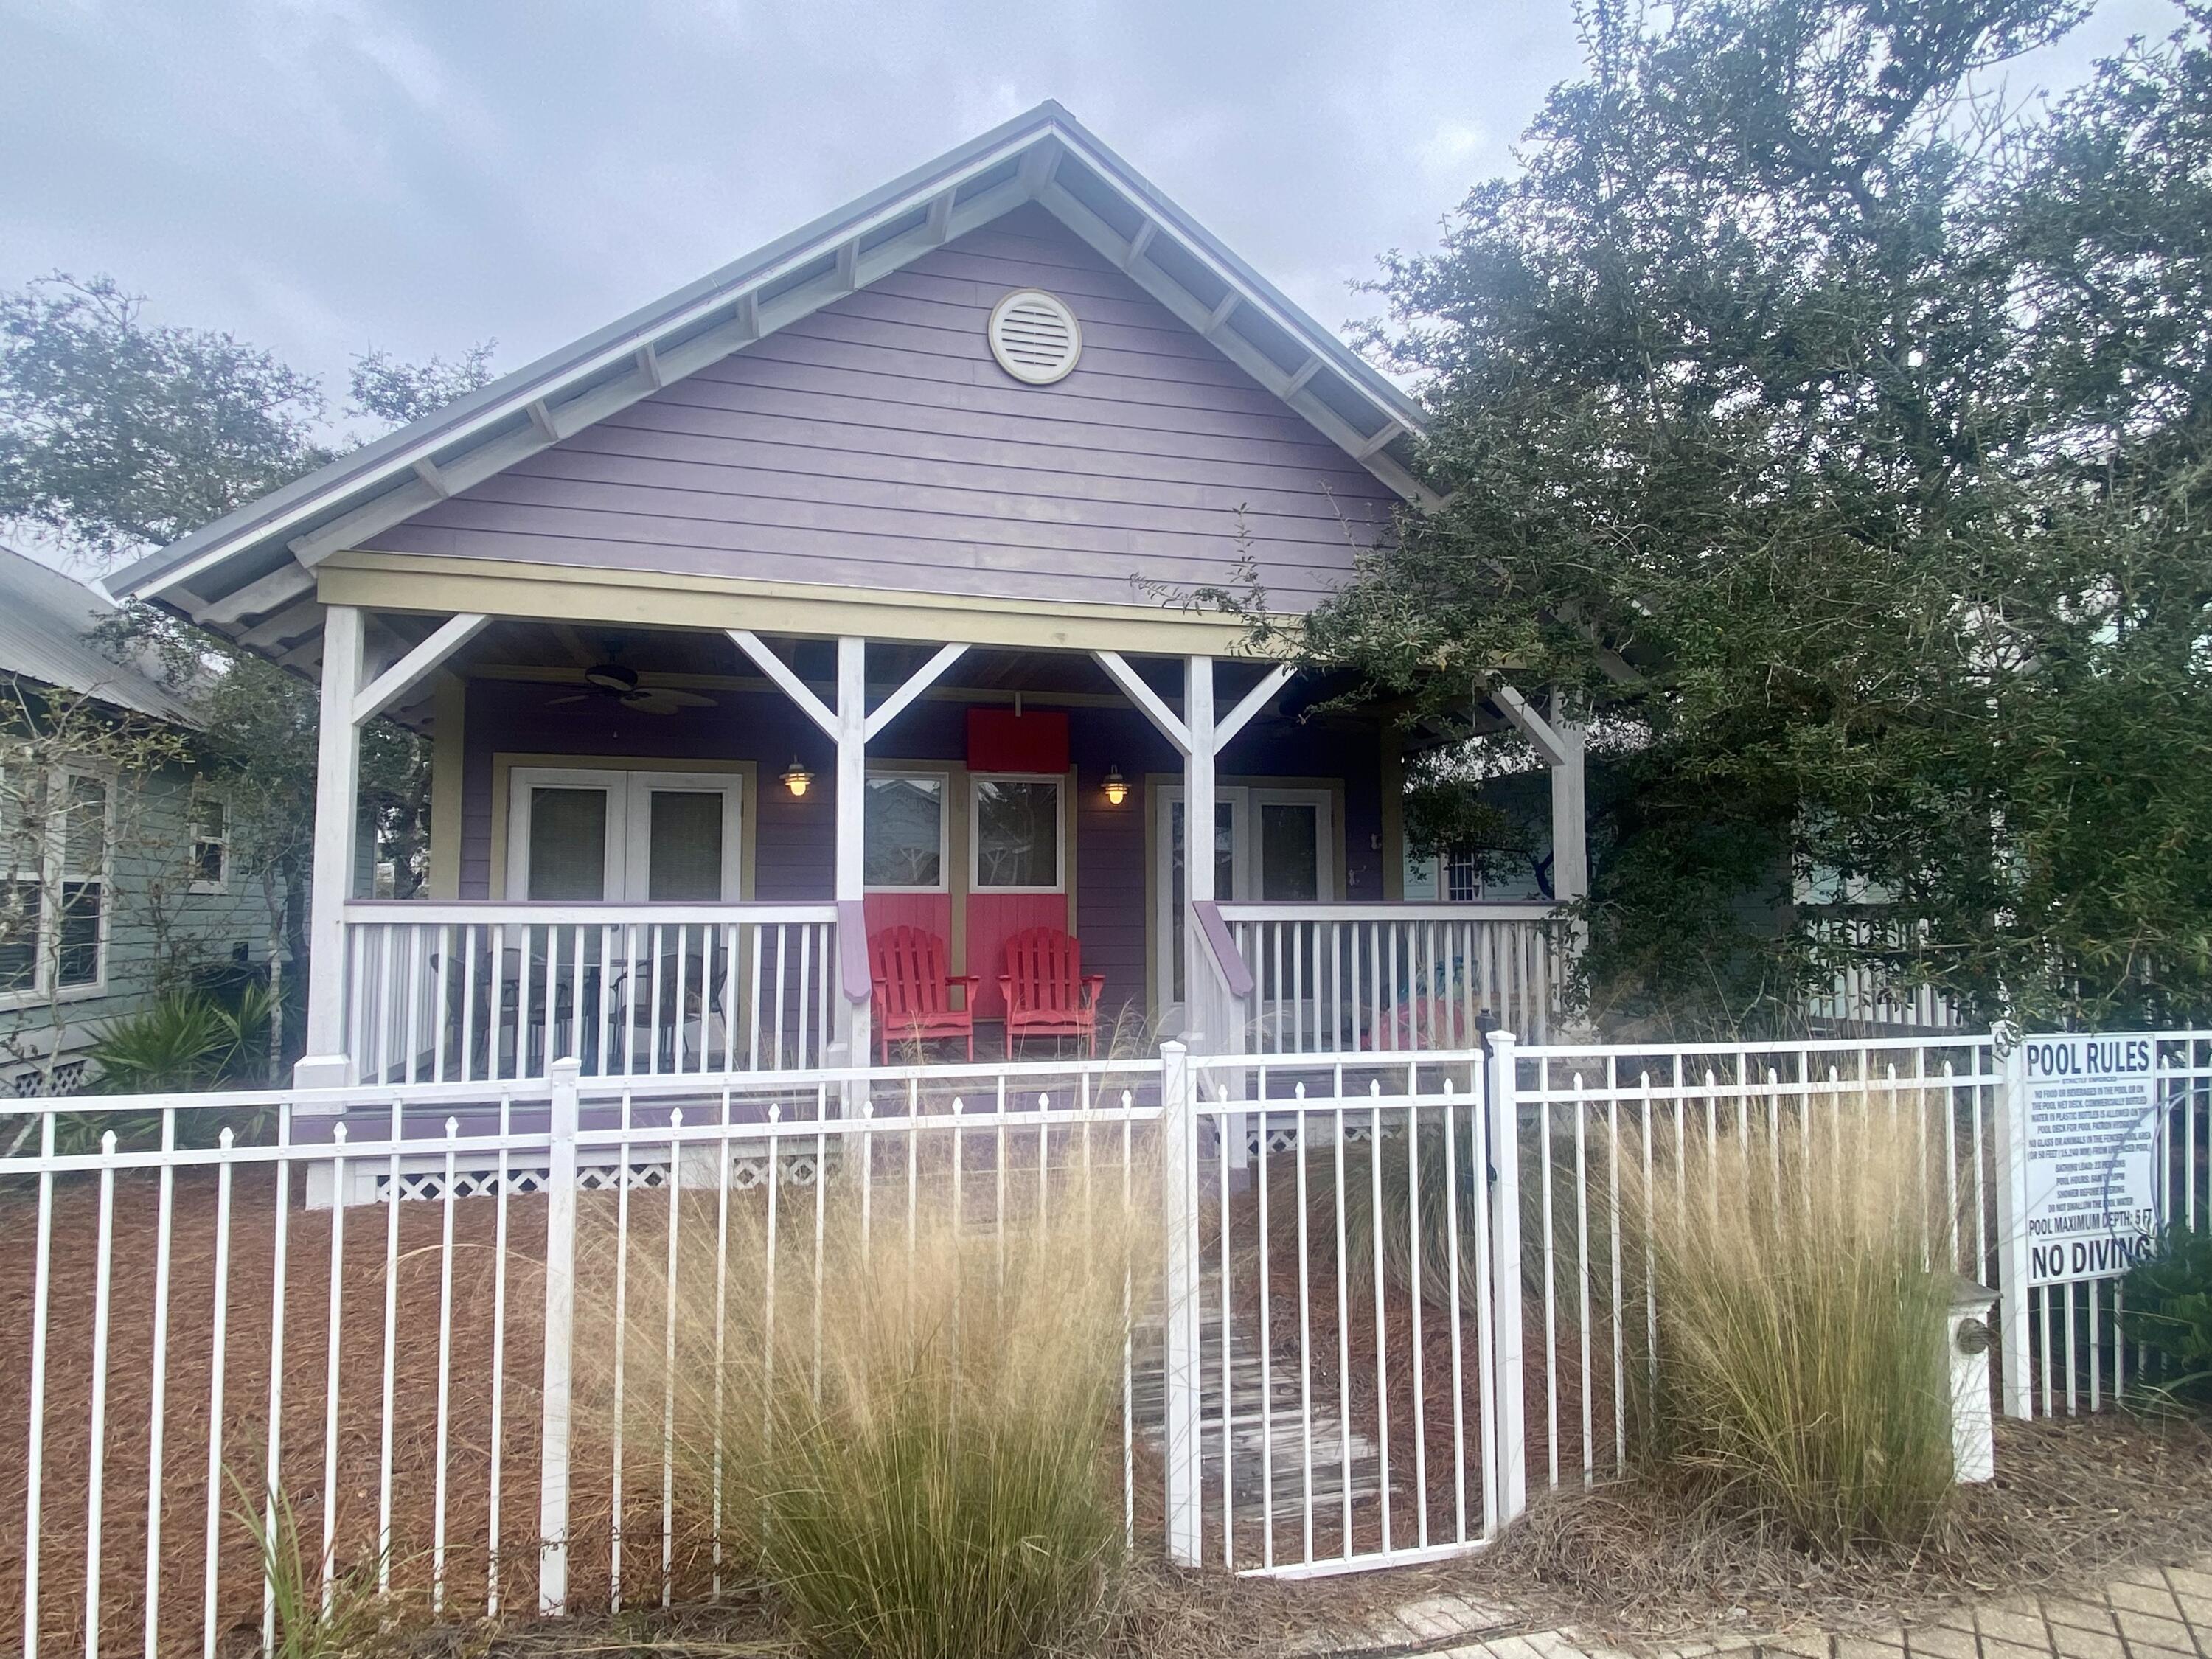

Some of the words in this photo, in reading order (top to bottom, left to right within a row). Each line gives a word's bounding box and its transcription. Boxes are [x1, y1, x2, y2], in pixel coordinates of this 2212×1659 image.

[2028, 1044, 2081, 1076] POOL
[2087, 1040, 2149, 1074] RULES
[2044, 1090, 2057, 1098] FOOD
[2067, 1088, 2096, 1096] BEVERAGES
[2098, 1087, 2103, 1095] IN
[2104, 1086, 2113, 1095] THE
[2115, 1086, 2127, 1094] POOL
[2032, 1102, 2041, 1110] THE
[2042, 1102, 2056, 1110] POOL
[2085, 1099, 2124, 1107] COMMERCIALLY
[2126, 1096, 2147, 1105] BOTTLED
[2031, 1113, 2048, 1122] WATER
[2056, 1113, 2077, 1121] PLASTIC
[2079, 1110, 2098, 1119] BOTTLES
[2107, 1109, 2129, 1117] ALLOWED
[2037, 1126, 2051, 1134] POOL
[2052, 1124, 2065, 1133] DECK
[2067, 1124, 2076, 1132] FOR
[2079, 1123, 2090, 1131] POOL
[2093, 1121, 2111, 1130] PATRON
[2037, 1138, 2053, 1147] GLASS
[2055, 1138, 2062, 1146] OR
[2063, 1136, 2086, 1145] ANIMALS
[2093, 1135, 2103, 1143] THE
[2139, 1132, 2151, 1140] AREA
[2038, 1150, 2045, 1158] 50
[2045, 1150, 2057, 1158] FEET
[2093, 1147, 2107, 1155] FROM
[2056, 1163, 2077, 1172] BATHING
[2102, 1160, 2125, 1169] PERONS
[2056, 1177, 2069, 1186] POOL
[2070, 1175, 2090, 1184] HOURS:
[2057, 1189, 2078, 1198] SHOWER
[2080, 1188, 2099, 1197] BEFORE
[2101, 1186, 2124, 1195] ETERING
[2048, 1204, 2055, 1213] DO
[2056, 1203, 2065, 1211] NOT
[2067, 1201, 2091, 1211] SWALLOW
[2093, 1200, 2101, 1208] THE
[2103, 1199, 2115, 1208] OOL
[2117, 1197, 2133, 1206] WATER
[2029, 1219, 2052, 1236] POOL
[2055, 1214, 2099, 1233] MAXIMUM
[2102, 1211, 2132, 1228] DEPTH:
[2135, 1209, 2140, 1224] 5
[2143, 1209, 2152, 1225] FT
[2032, 1245, 2064, 1279] NO
[2072, 1236, 2151, 1273] DIVING
